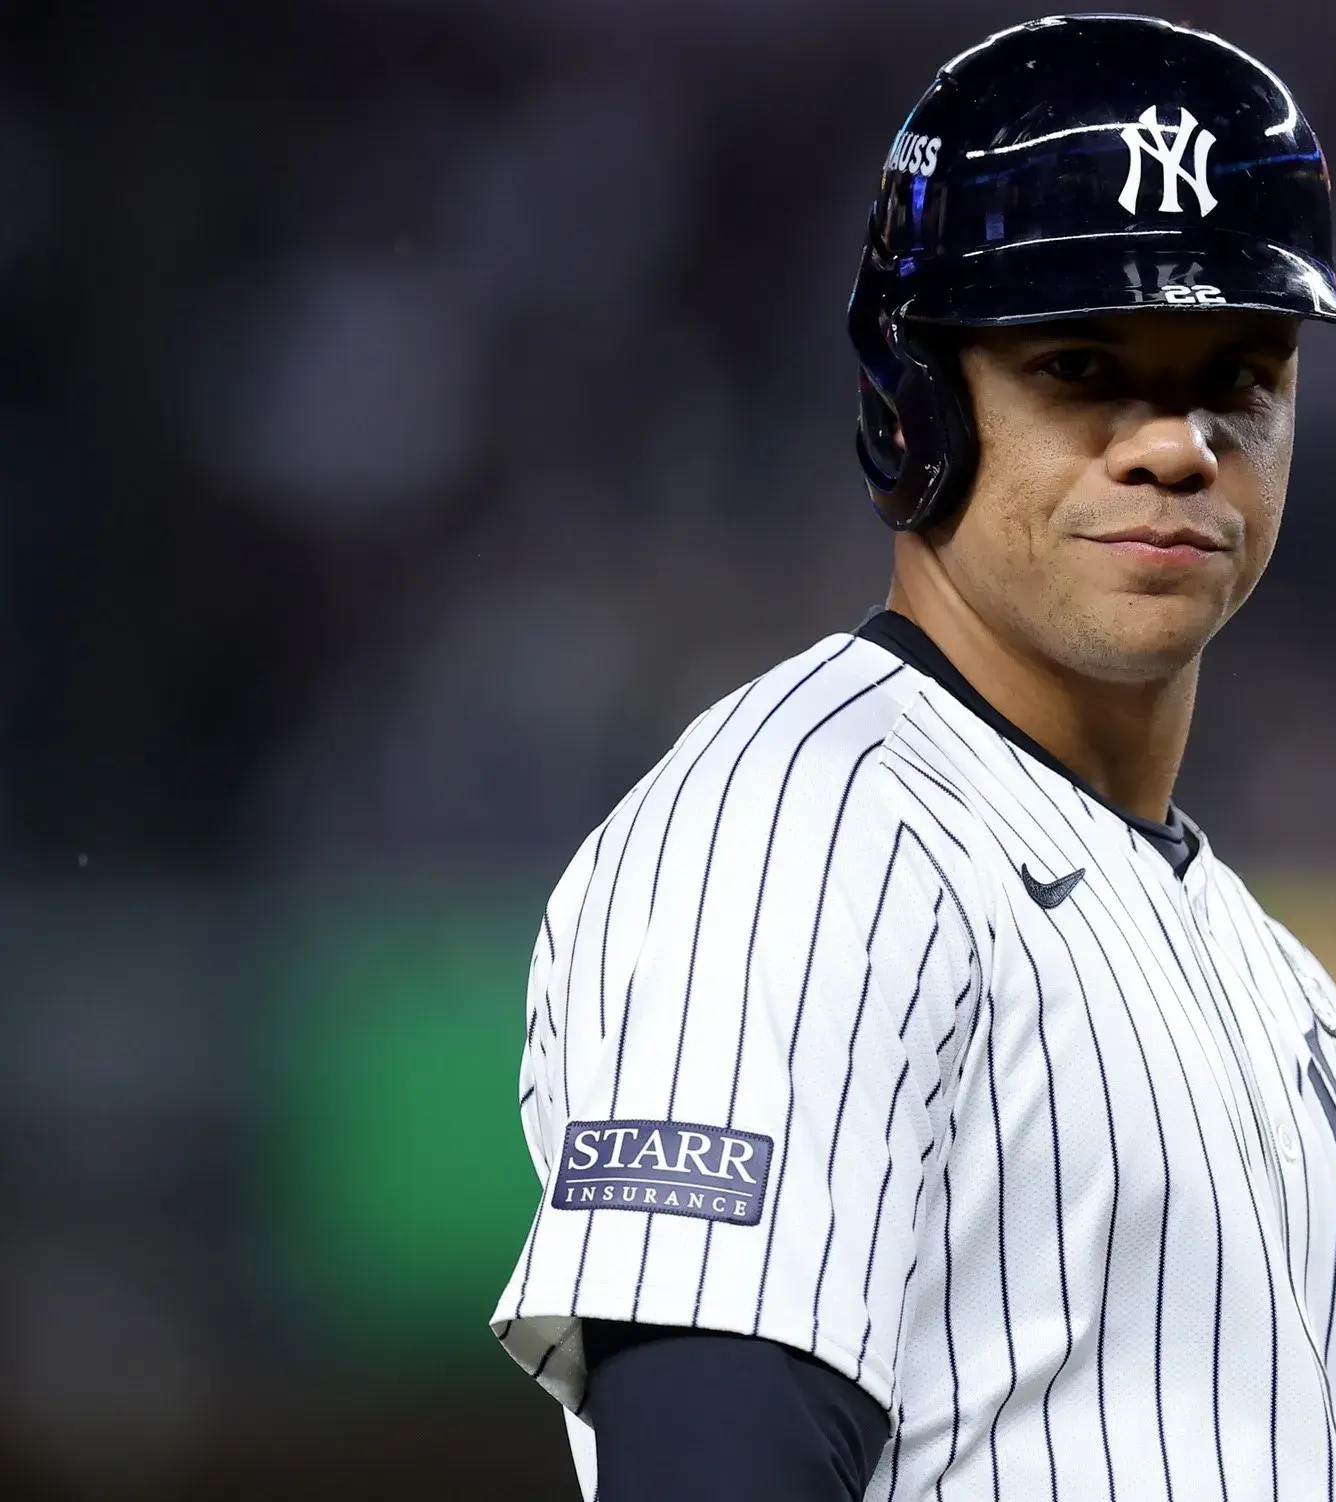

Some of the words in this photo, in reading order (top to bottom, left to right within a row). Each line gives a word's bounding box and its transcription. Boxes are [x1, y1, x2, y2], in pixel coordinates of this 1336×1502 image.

[1118, 104, 1219, 218] NY
[1161, 285, 1227, 304] 22
[568, 1128, 757, 1184] STARR
[565, 1186, 747, 1217] INSURANCE
